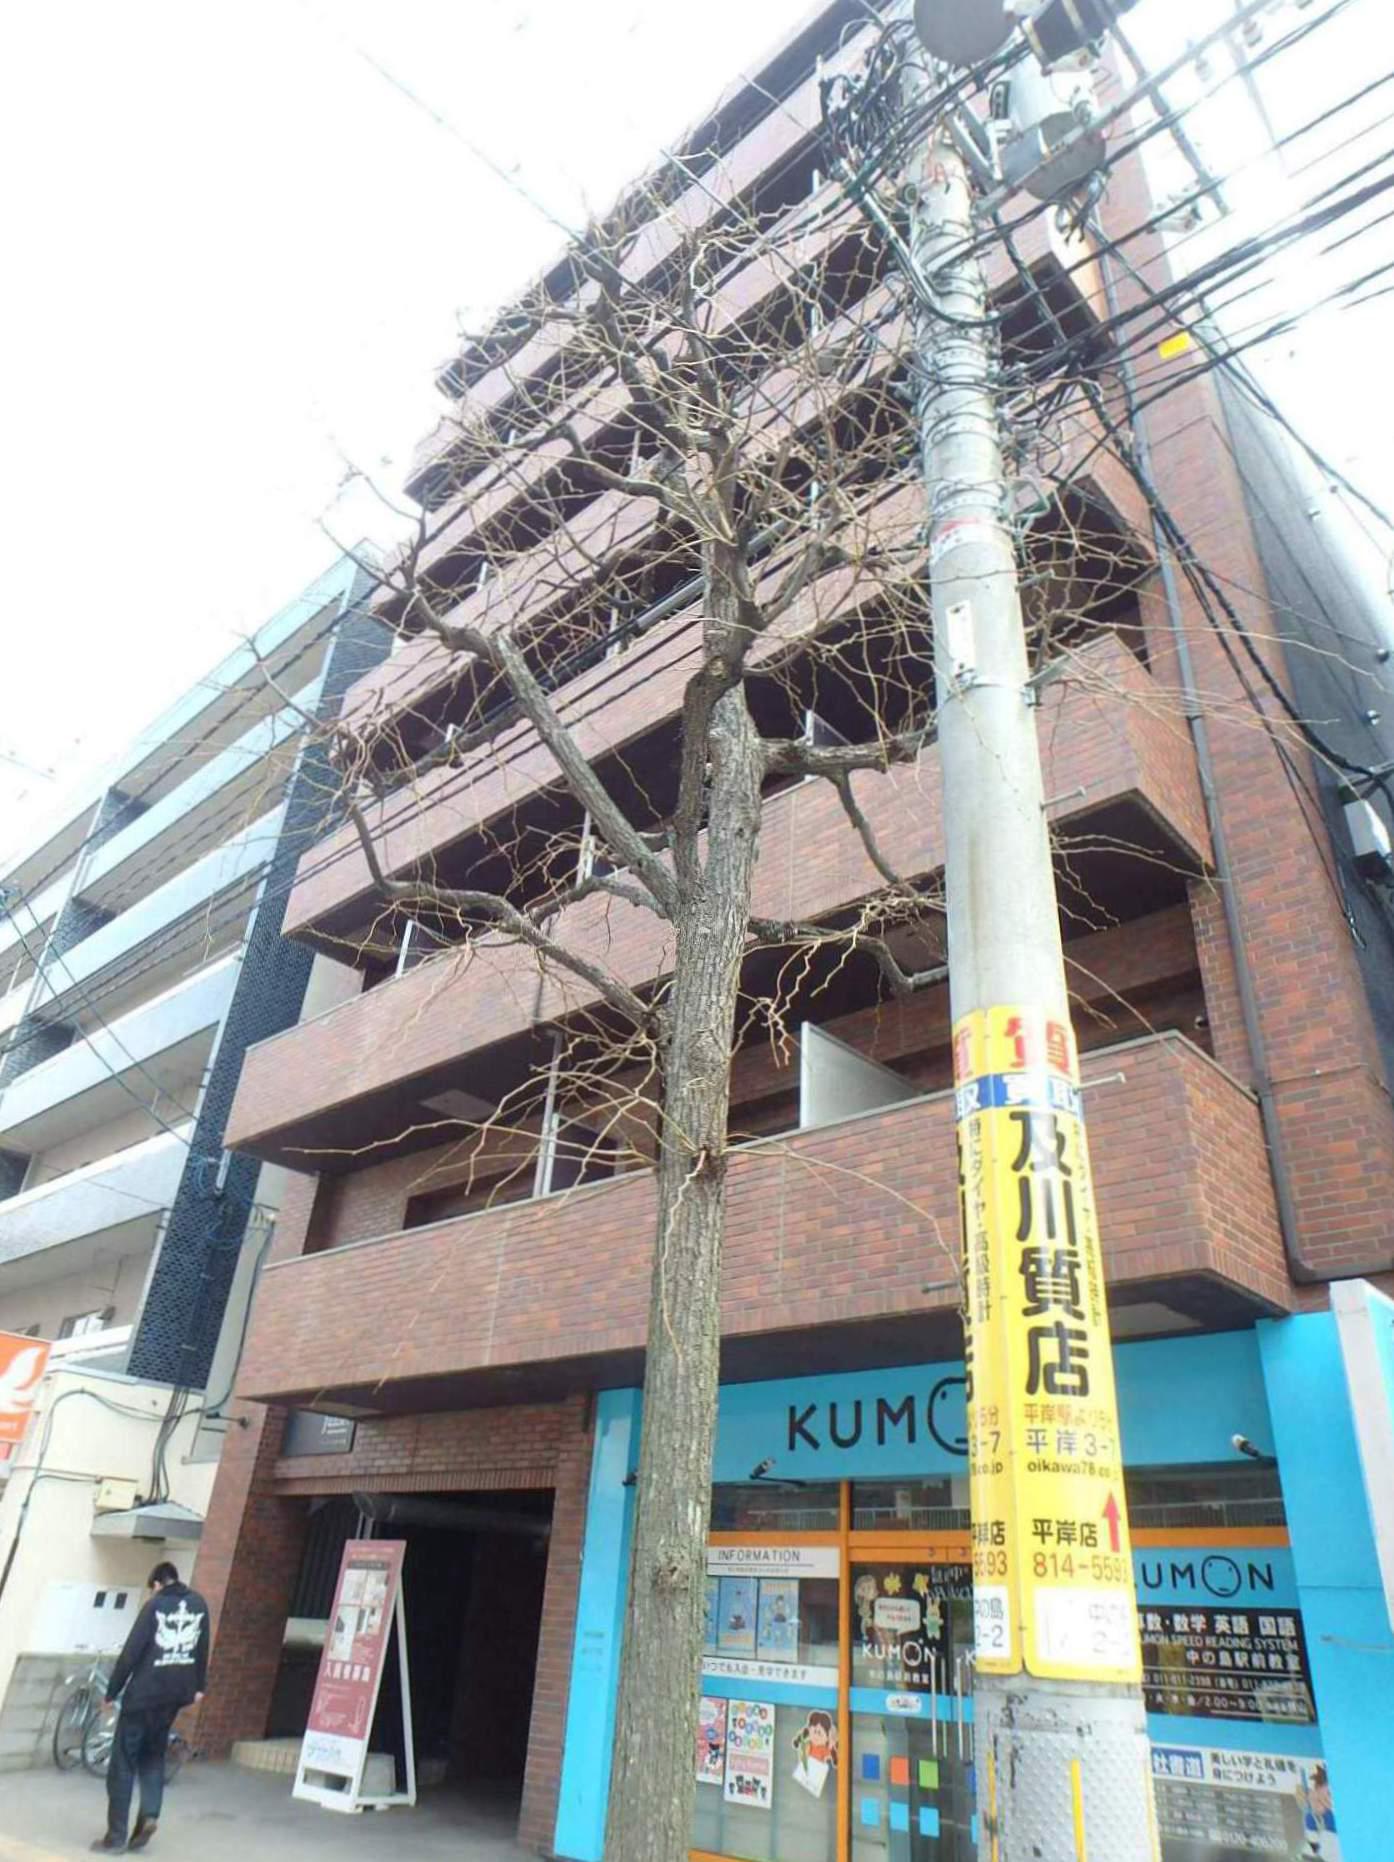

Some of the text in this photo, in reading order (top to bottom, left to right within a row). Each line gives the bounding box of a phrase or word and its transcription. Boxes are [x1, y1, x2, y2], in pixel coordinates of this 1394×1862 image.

[1008, 1111, 1090, 1396] 及川質店
[1031, 1518, 1099, 1549] 平岸店
[718, 1549, 801, 1562] INFORMATION
[861, 1640, 938, 1667] KUMON
[1205, 1636, 1252, 1651] READING
[1254, 1639, 1299, 1653] SYSTEM
